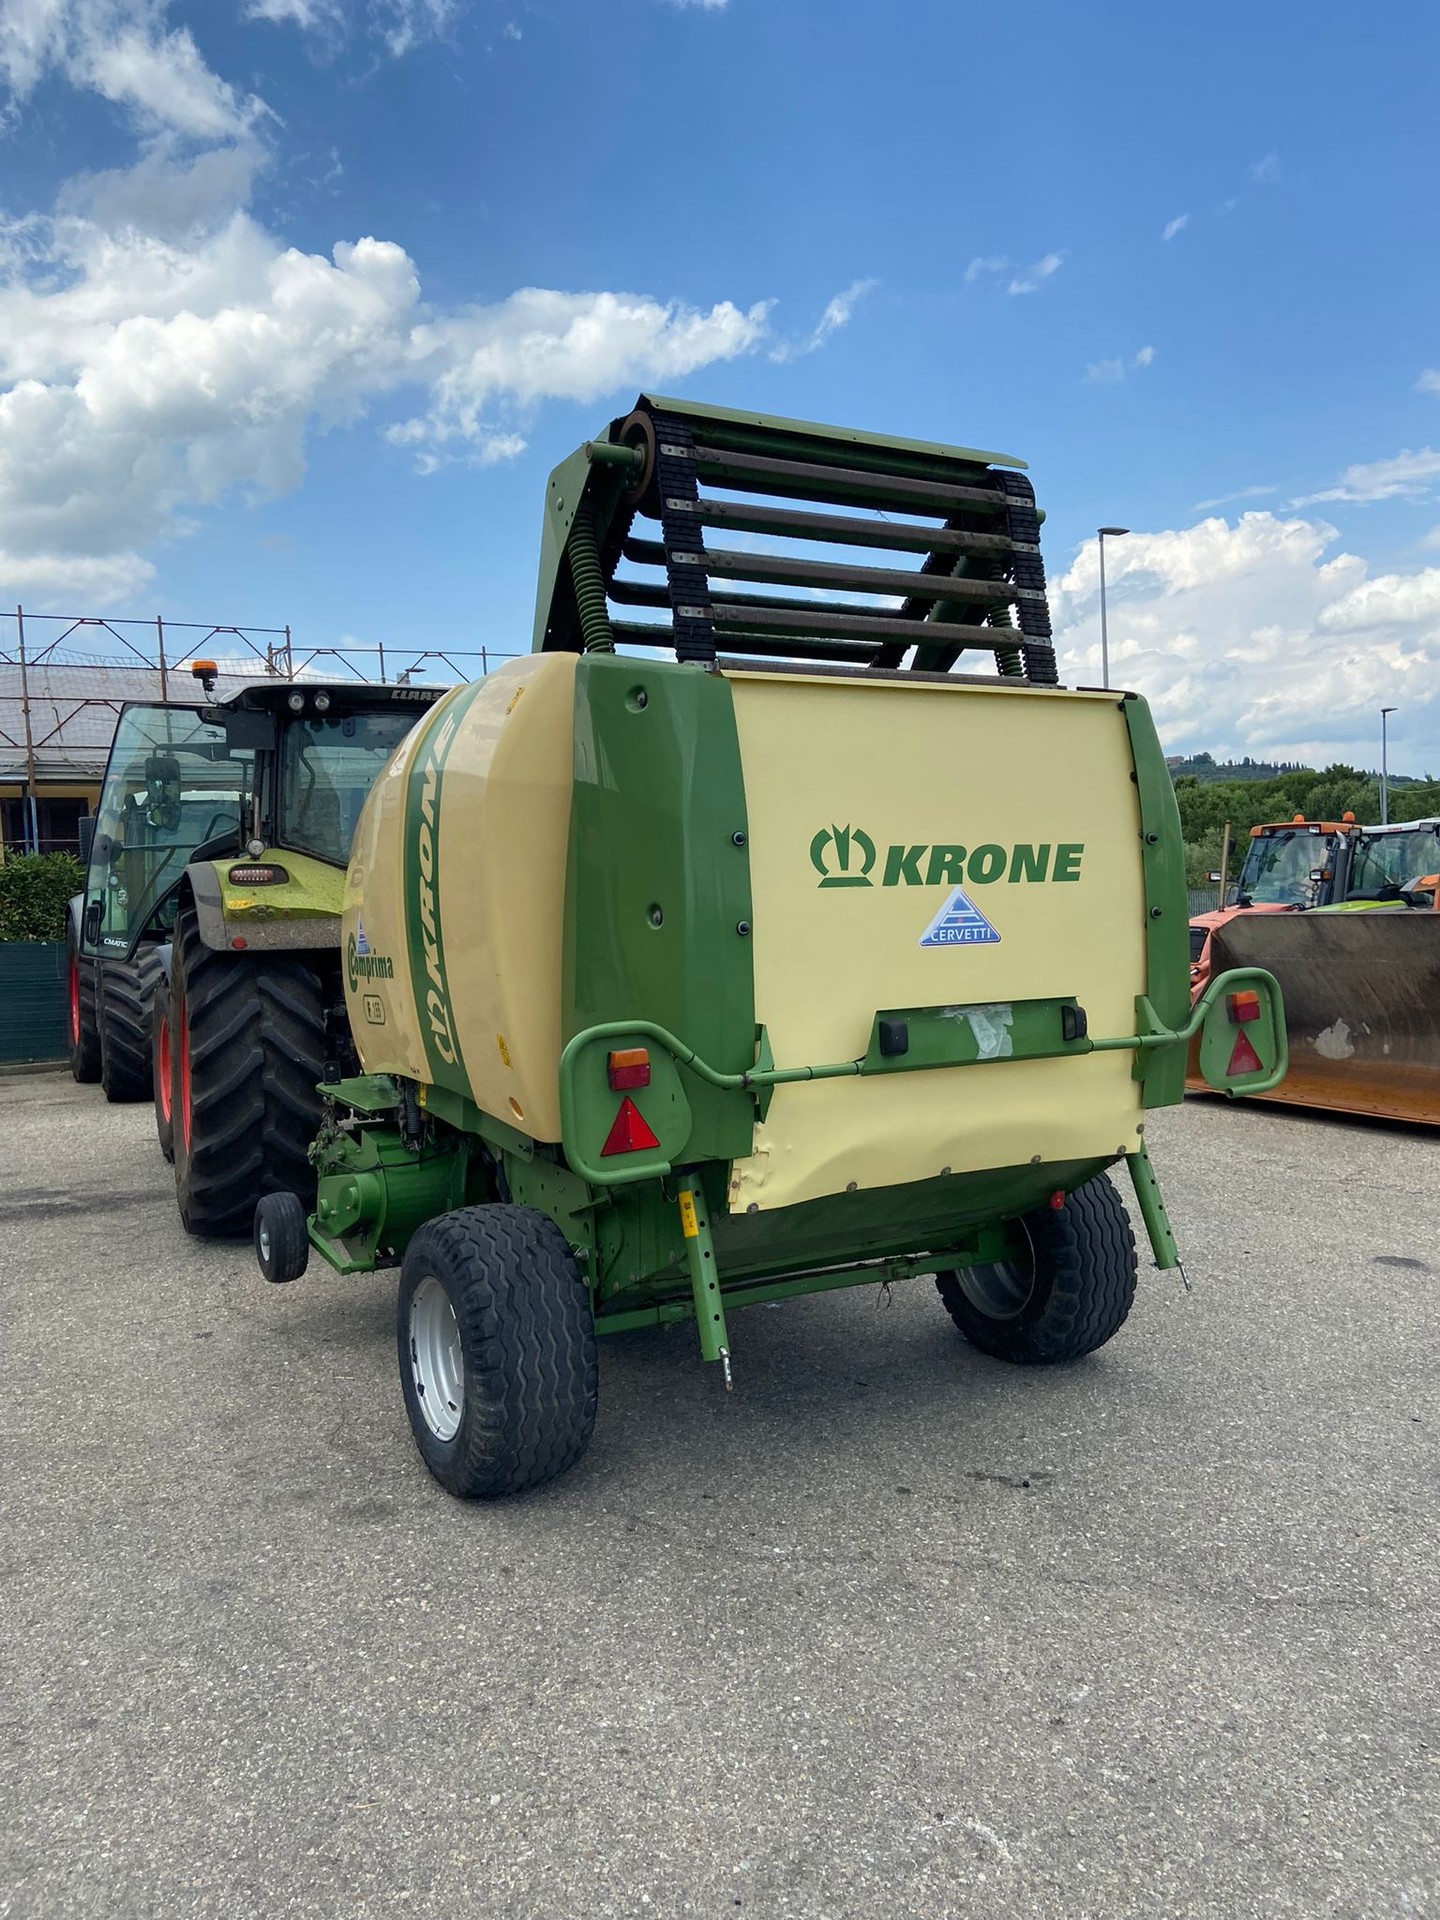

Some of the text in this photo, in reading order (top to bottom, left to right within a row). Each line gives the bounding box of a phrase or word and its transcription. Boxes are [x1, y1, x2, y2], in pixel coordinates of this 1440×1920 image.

[391, 690, 442, 701] CLAAS
[419, 711, 456, 995] KRONE
[882, 843, 1085, 887] KRONE
[930, 927, 991, 942] CERVETTI
[348, 931, 395, 994] Comprima
